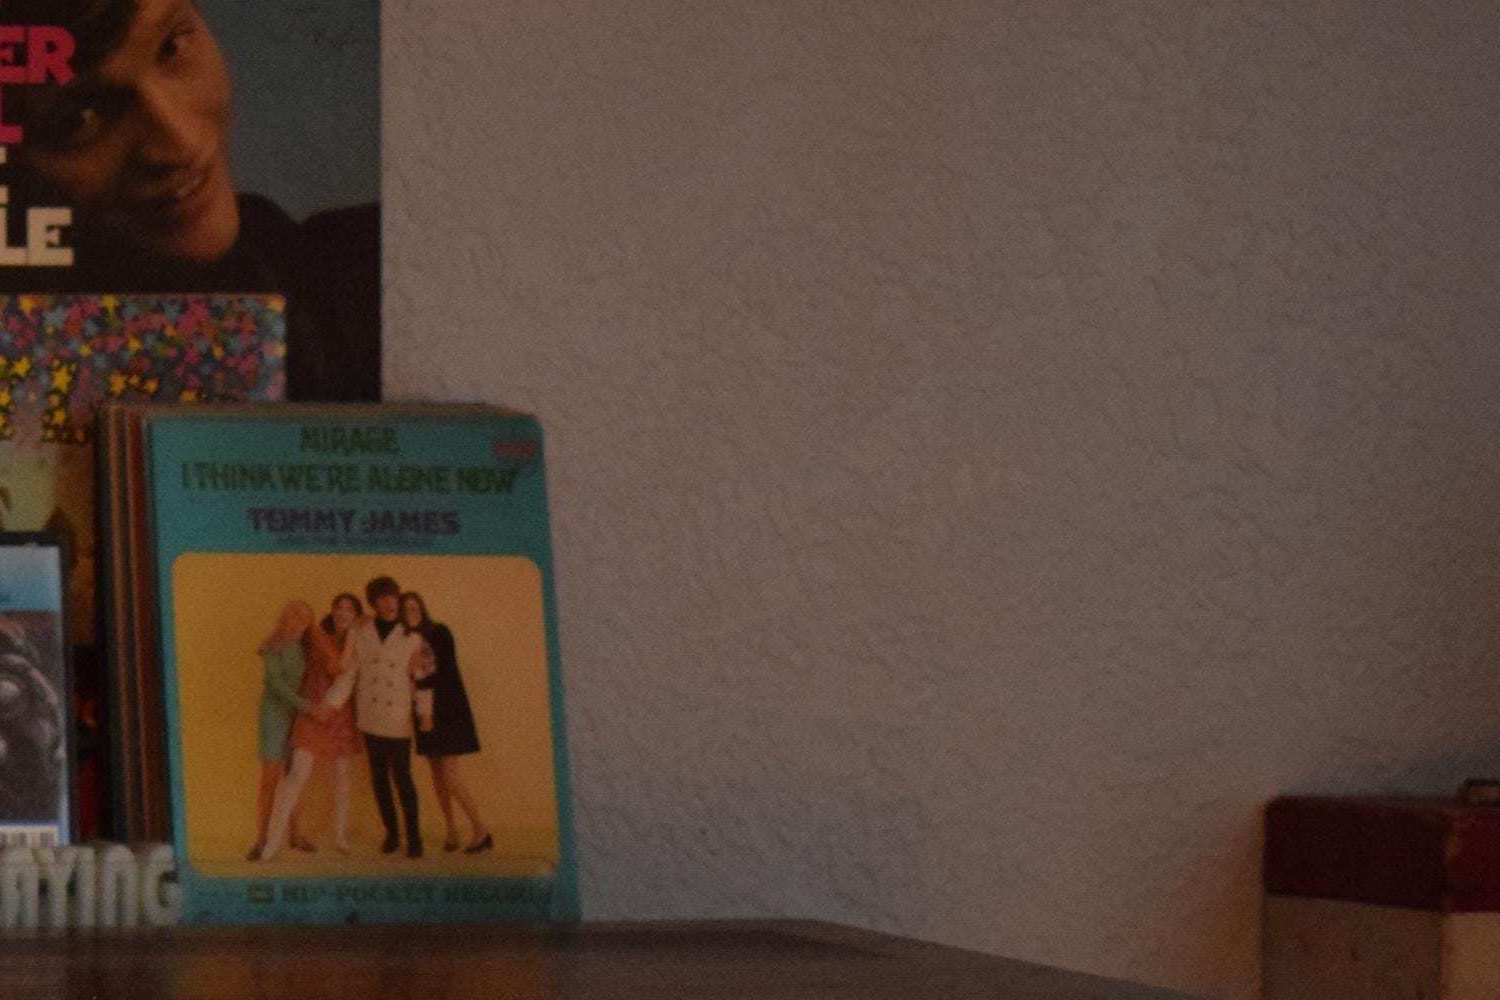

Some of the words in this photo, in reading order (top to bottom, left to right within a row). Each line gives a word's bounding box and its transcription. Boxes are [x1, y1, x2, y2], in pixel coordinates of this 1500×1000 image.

[300, 426, 400, 454] MIRAGE
[181, 462, 190, 489] I
[196, 463, 277, 491] THINK
[368, 465, 451, 493] ALONE
[457, 466, 520, 494] NOW
[248, 507, 355, 533] TOMMY
[360, 509, 461, 534] JAMES
